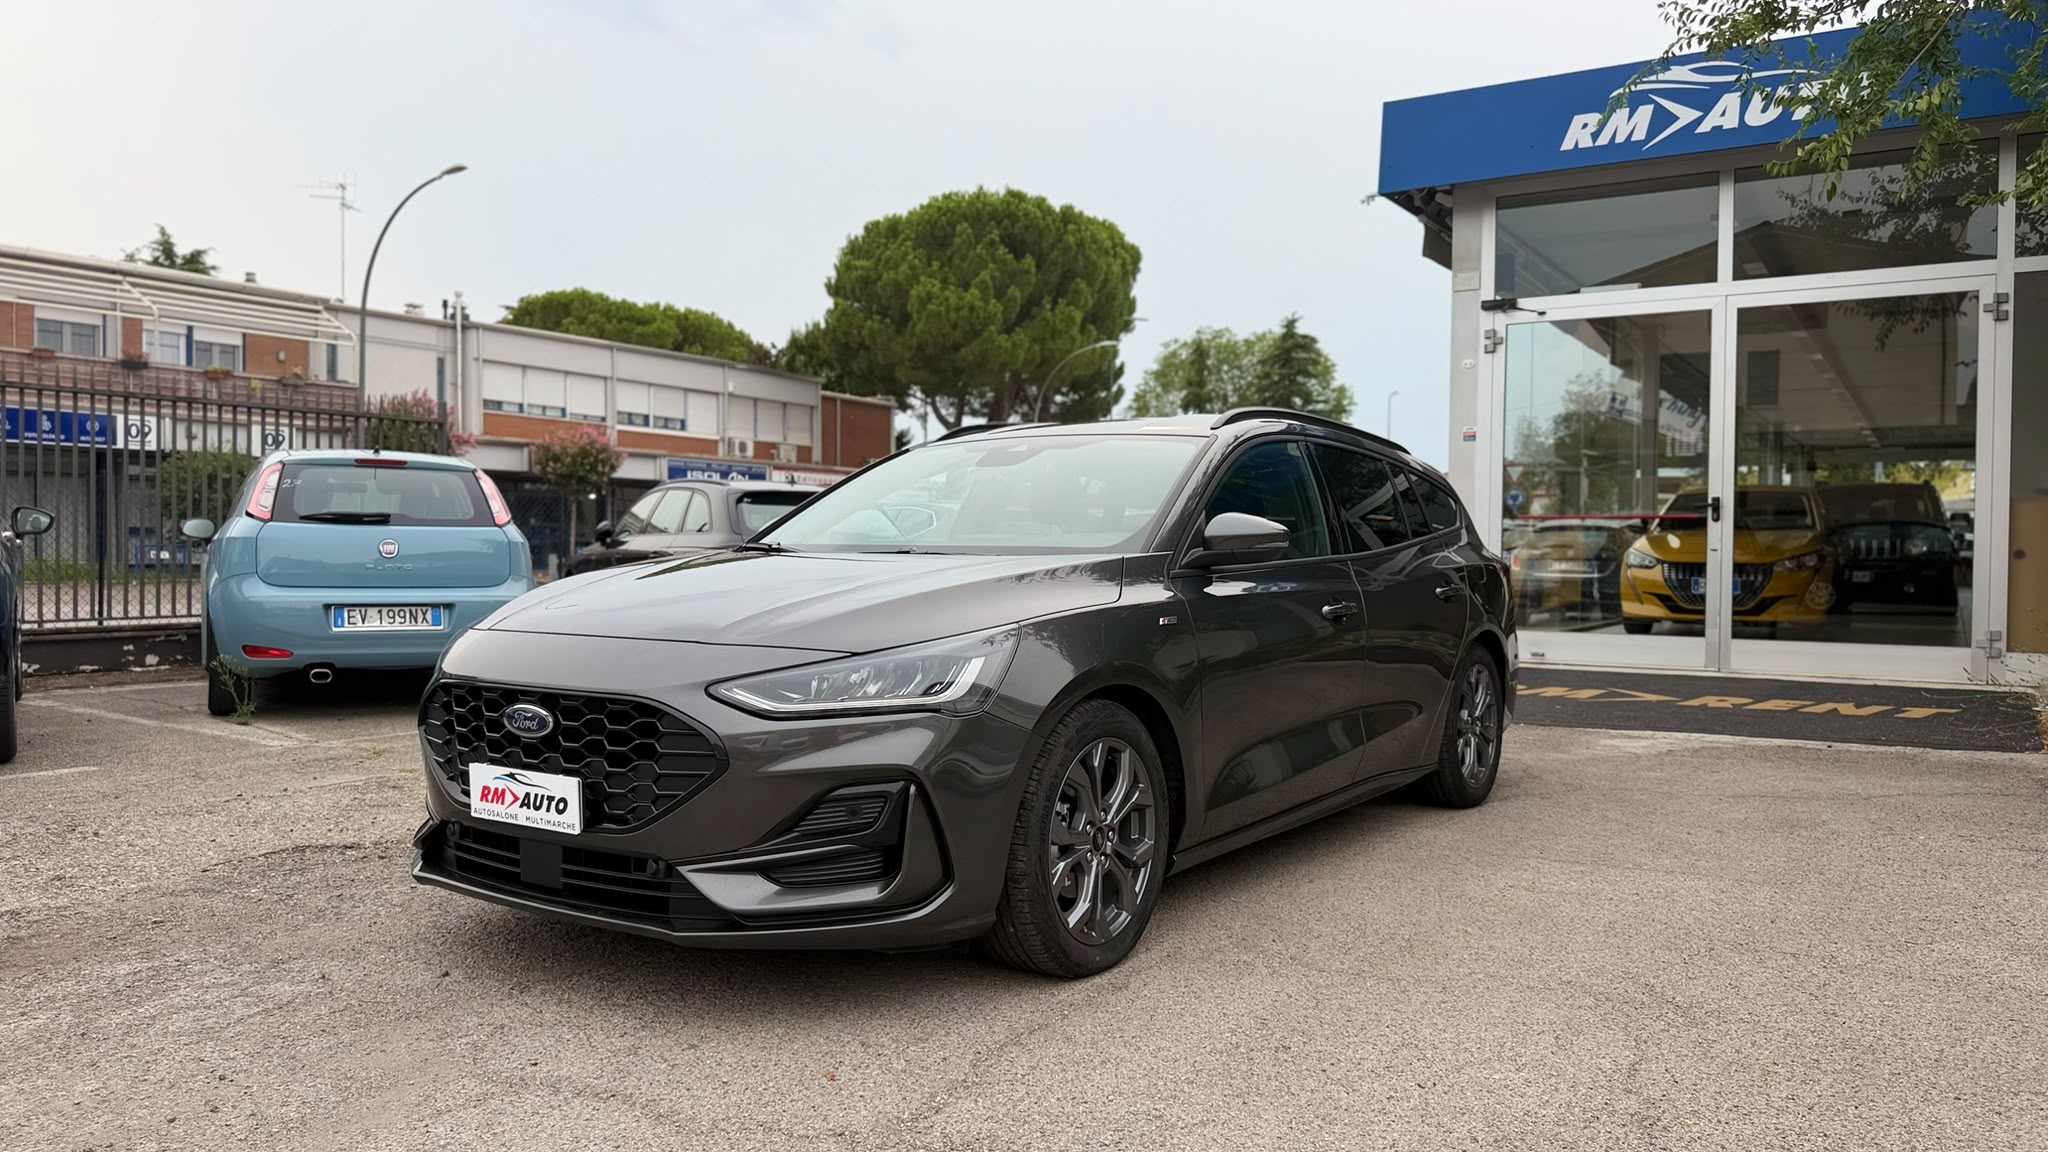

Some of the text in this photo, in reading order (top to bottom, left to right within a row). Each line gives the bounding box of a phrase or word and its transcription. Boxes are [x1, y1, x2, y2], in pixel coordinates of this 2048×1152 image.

[1560, 103, 1655, 151] RM
[347, 609, 368, 625] EV
[377, 608, 430, 625] 199NX
[1676, 695, 1963, 718] RENT
[512, 711, 539, 730] Ford
[480, 785, 568, 815] RM AUTO
[474, 807, 576, 831] AUTOSALONE MULTIMARCHE
